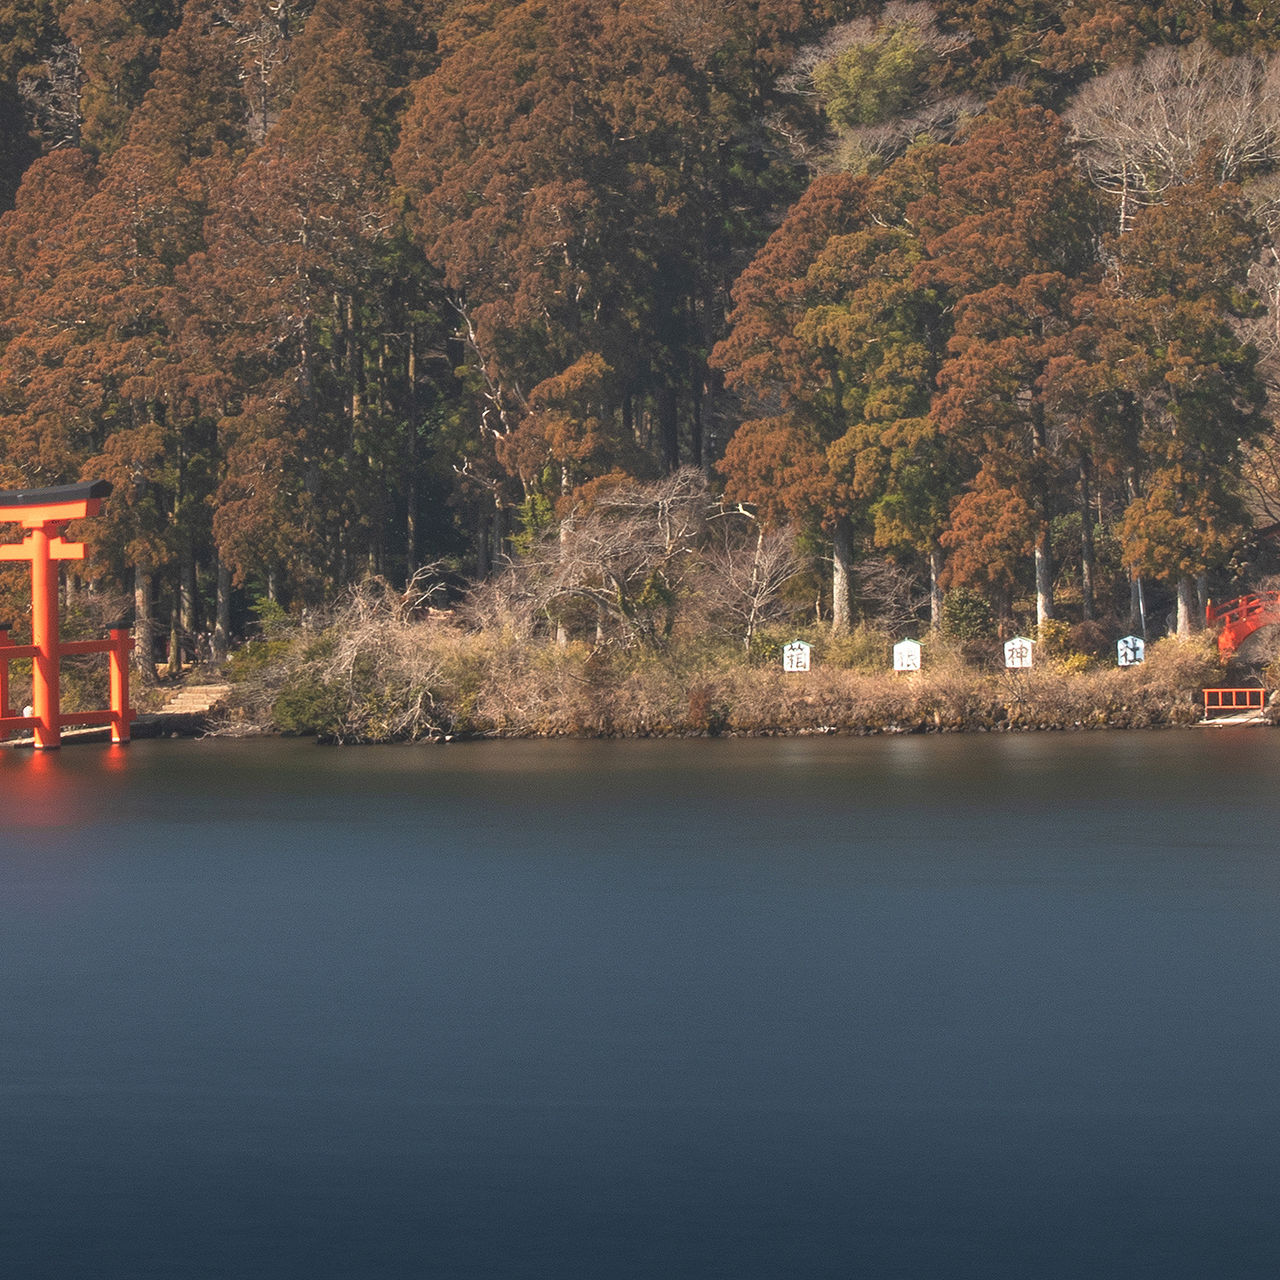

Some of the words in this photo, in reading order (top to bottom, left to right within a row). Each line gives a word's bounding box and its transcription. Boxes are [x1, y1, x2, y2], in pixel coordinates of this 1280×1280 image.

[786, 643, 807, 669] 箱
[1008, 639, 1029, 667] 神
[1120, 637, 1143, 664] 社
